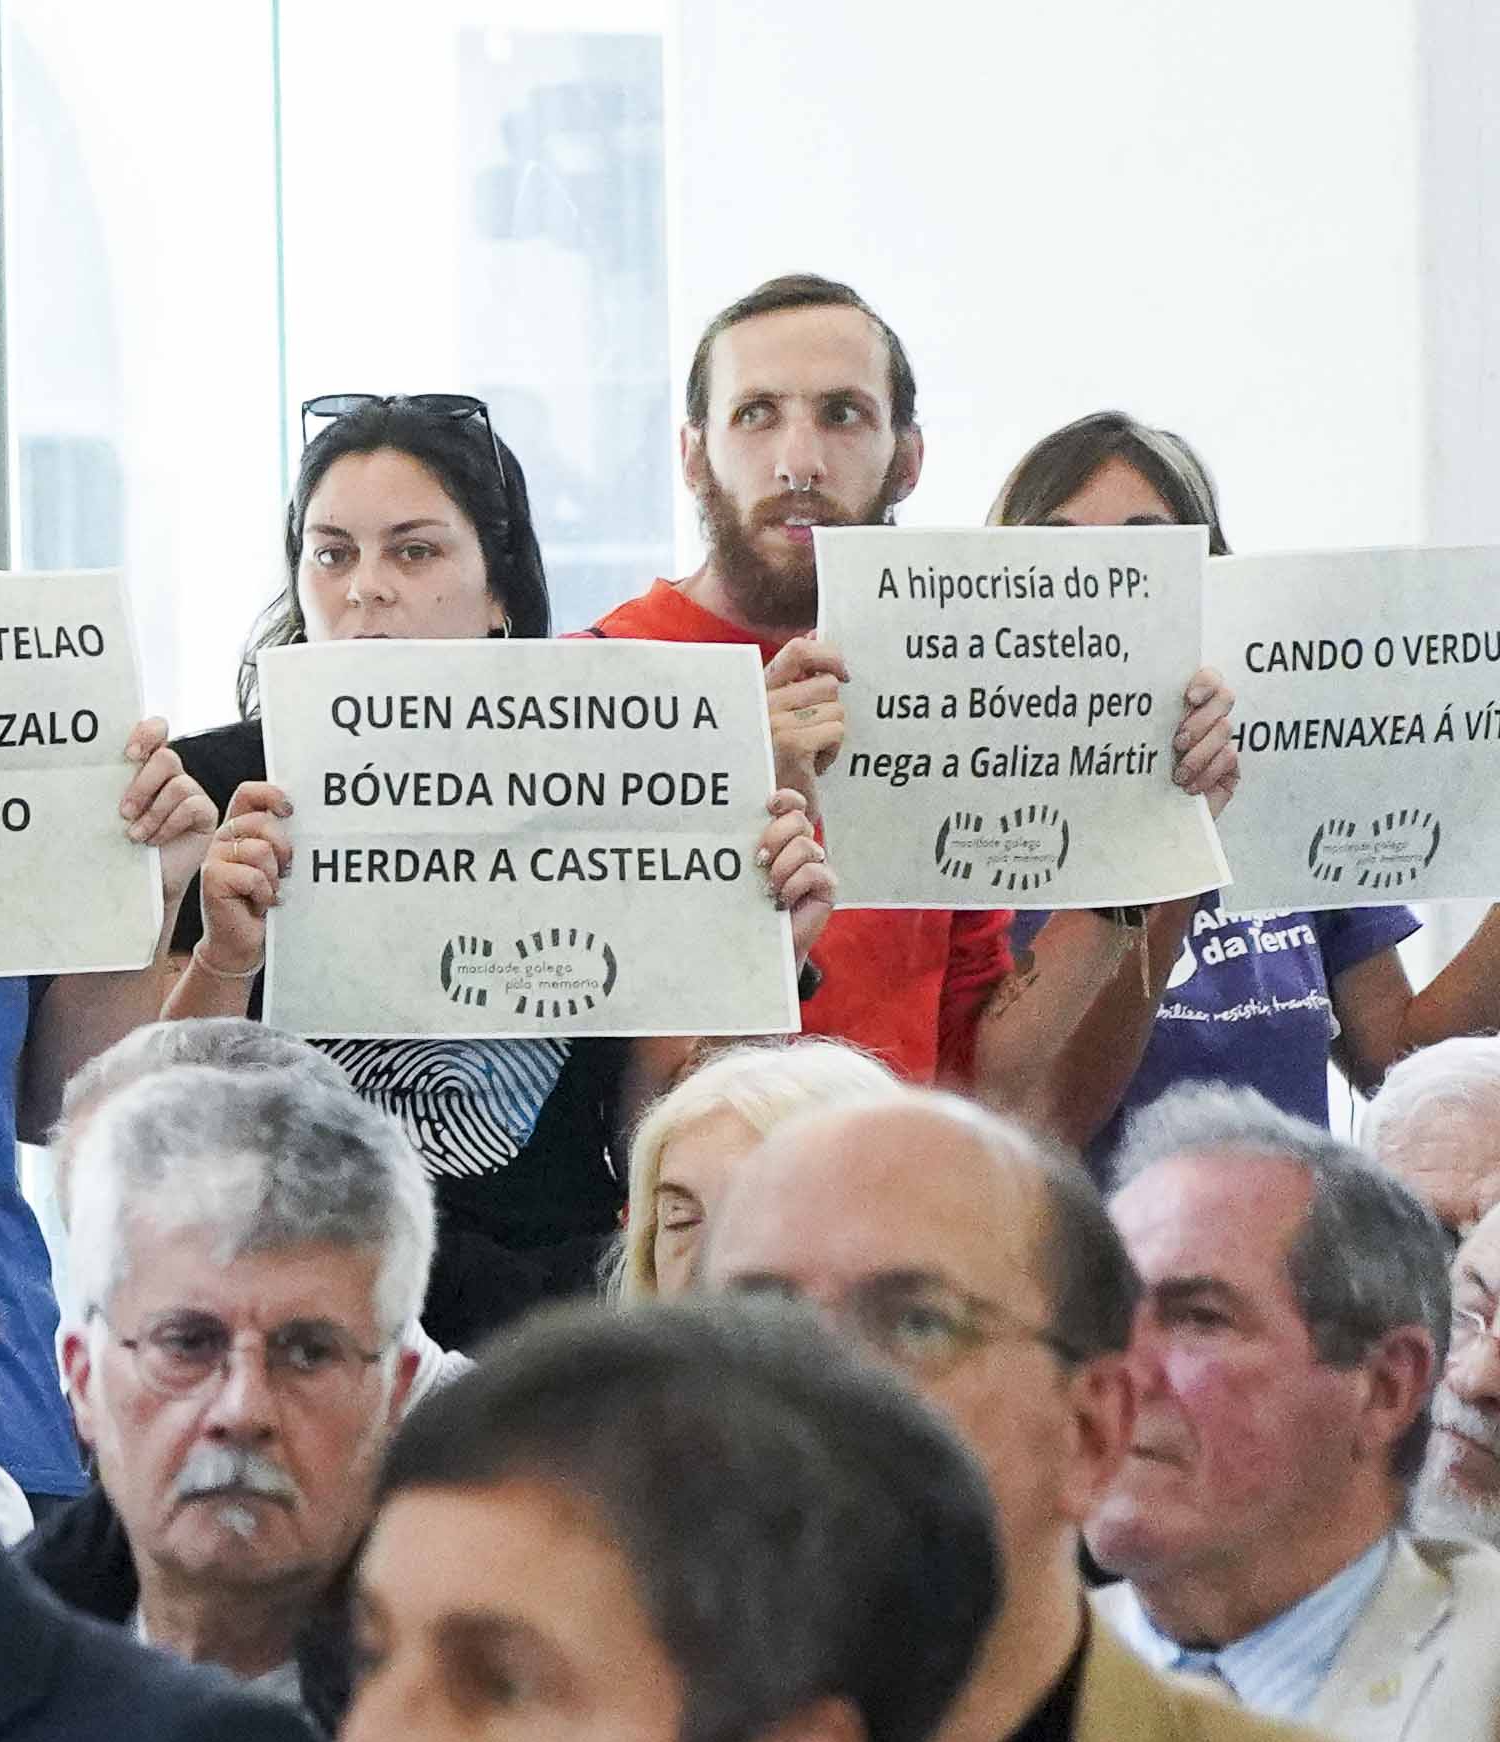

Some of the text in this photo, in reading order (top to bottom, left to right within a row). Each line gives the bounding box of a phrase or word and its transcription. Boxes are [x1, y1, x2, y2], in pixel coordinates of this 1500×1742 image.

[878, 566, 1148, 608] A hipocrisía do PP:
[907, 626, 1128, 662] usa a Castelao,
[1246, 639, 1363, 673] CANDO
[1375, 637, 1393, 667] O
[332, 696, 718, 736] QUEN ASASINOU A
[877, 685, 1152, 727] usa a Bóveda pero
[1434, 704, 1454, 743] Á
[324, 763, 728, 806] BÓVEDA NON PODE
[849, 743, 1158, 787] nega a Galiza Mártir
[313, 848, 741, 883] HERDAR A CASTELAO
[1202, 924, 1316, 965] da Terra
